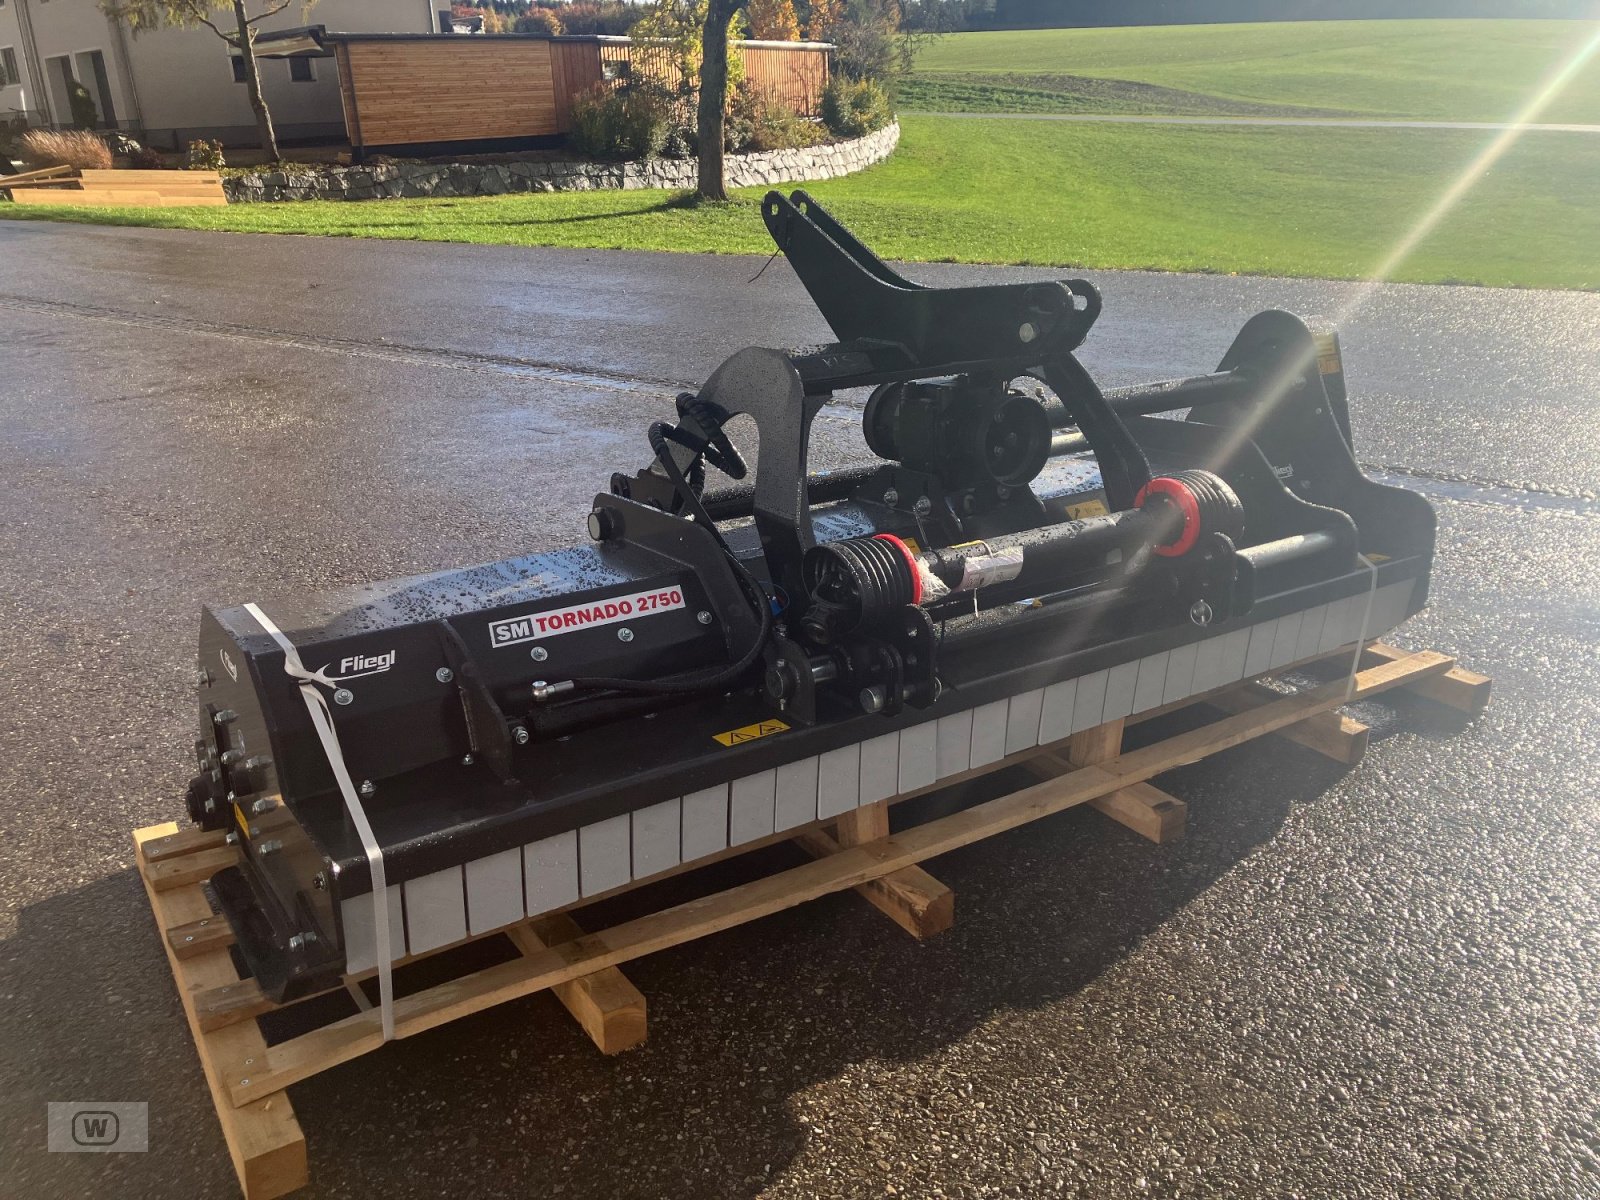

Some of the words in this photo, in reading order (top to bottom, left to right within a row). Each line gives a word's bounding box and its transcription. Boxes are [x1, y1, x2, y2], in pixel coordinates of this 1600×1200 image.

[496, 621, 530, 641] SM
[535, 600, 632, 632] TORNADO
[636, 590, 682, 612] 2750
[340, 649, 396, 674] Fliegl
